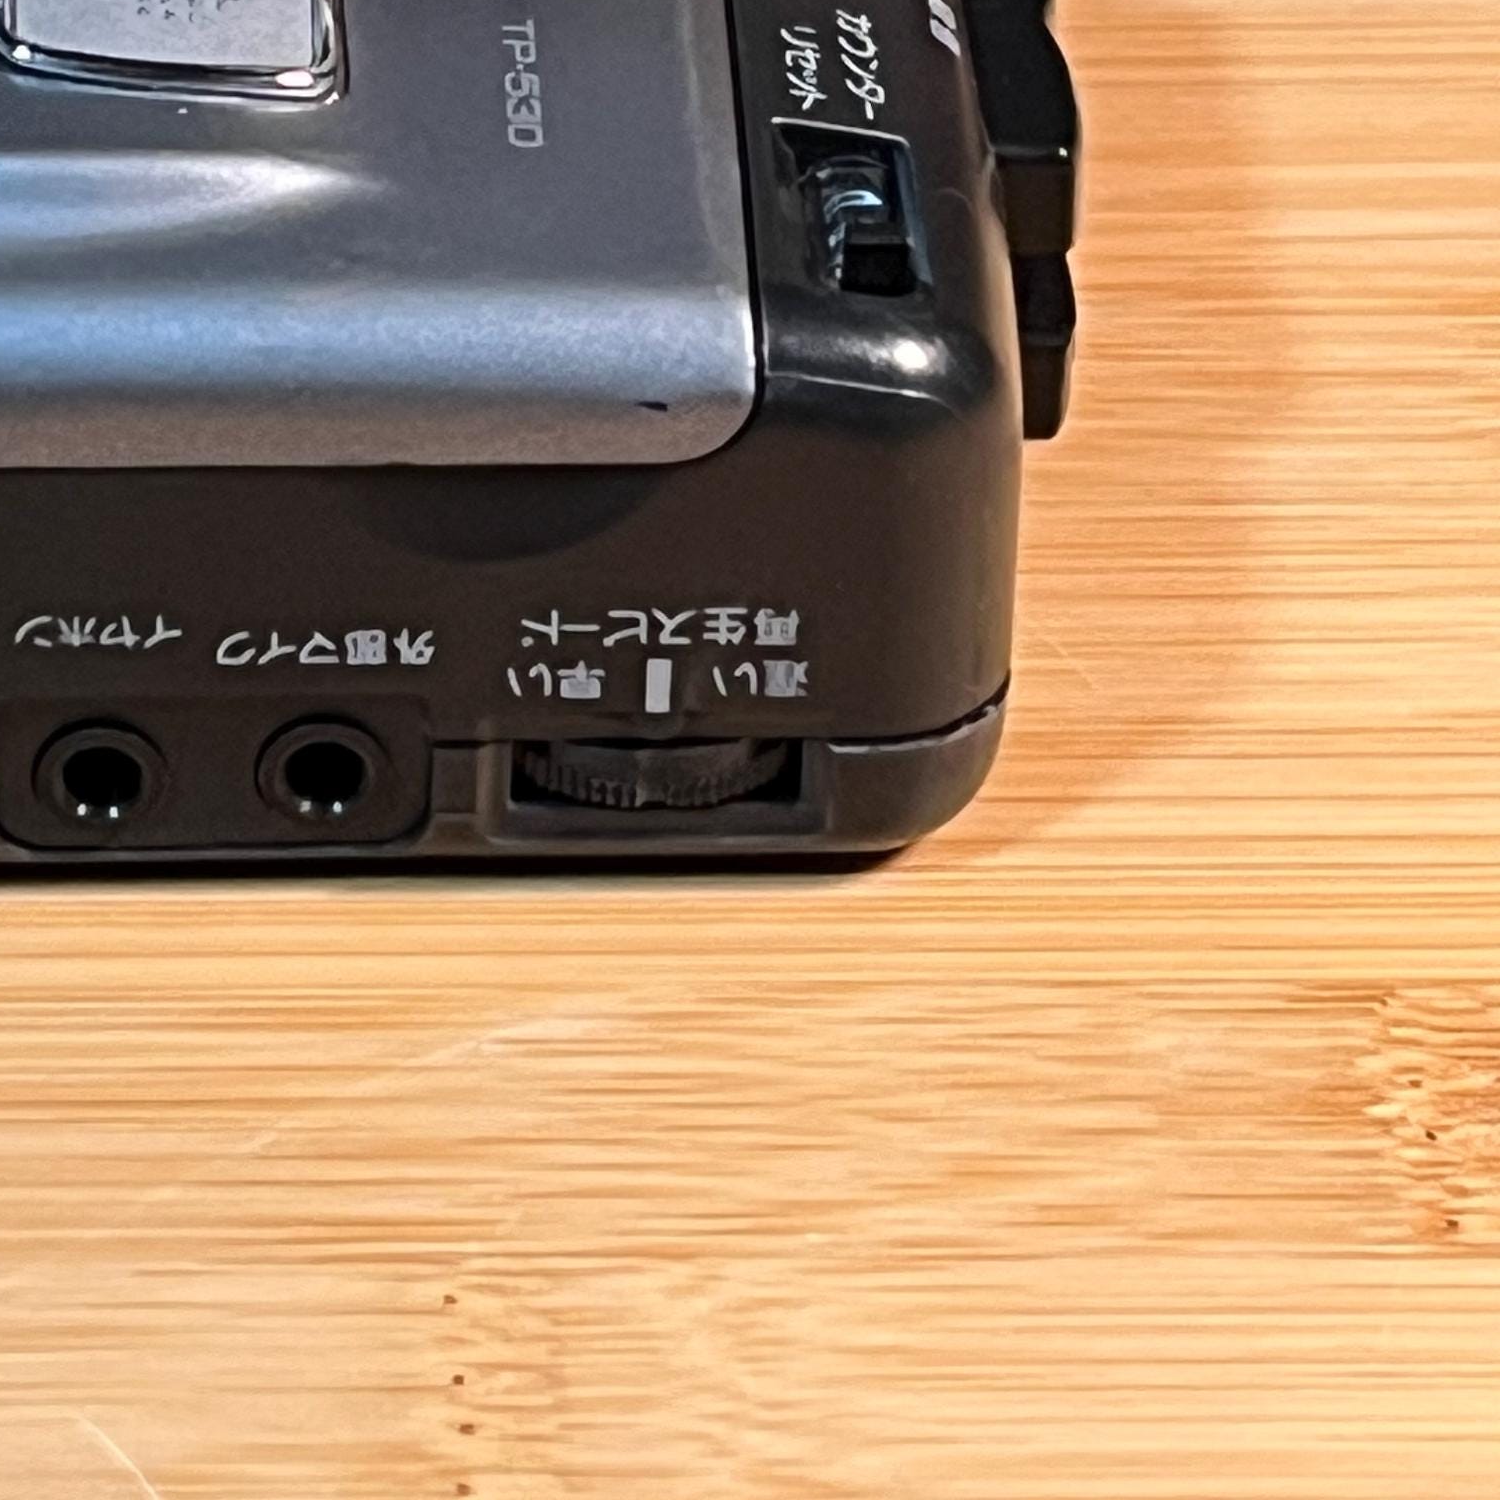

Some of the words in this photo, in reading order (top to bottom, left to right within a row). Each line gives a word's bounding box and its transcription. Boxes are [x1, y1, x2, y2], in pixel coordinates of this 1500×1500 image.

[835, 8, 885, 120] カウンター
[14, 613, 183, 649] イヤホン
[520, 607, 799, 647] 再生スピード
